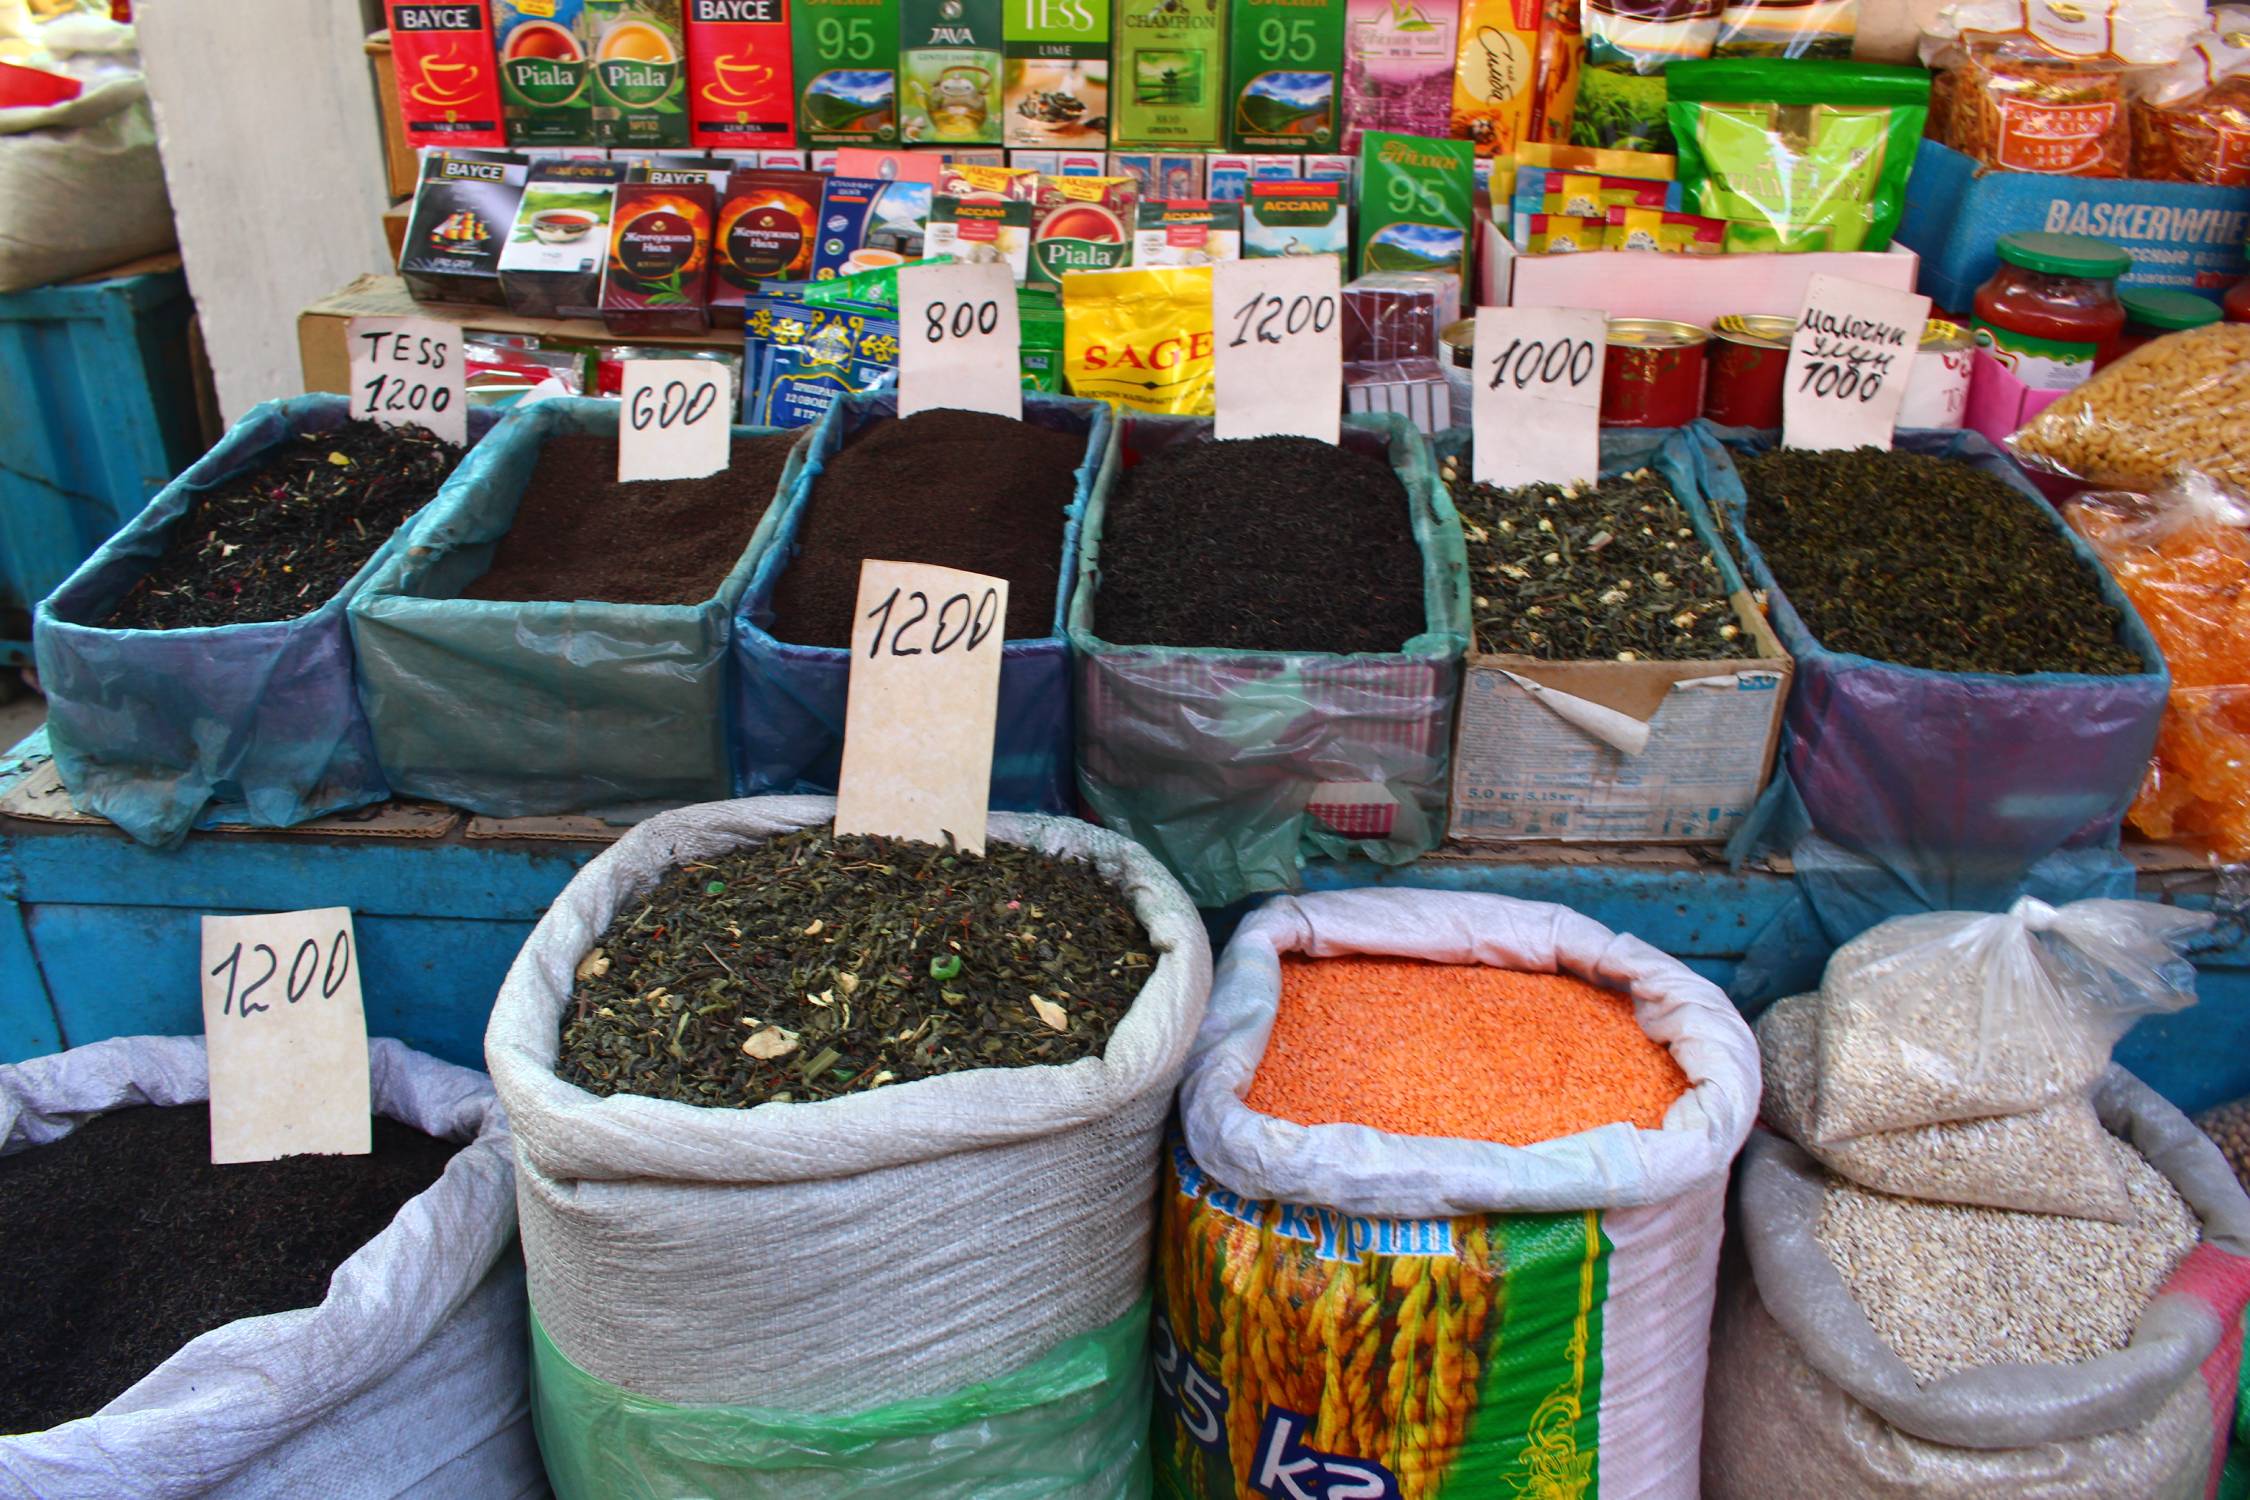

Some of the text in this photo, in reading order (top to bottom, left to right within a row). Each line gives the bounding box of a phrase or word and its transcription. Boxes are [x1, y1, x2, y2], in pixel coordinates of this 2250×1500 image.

[402, 9, 470, 28] BAYCE
[701, 0, 772, 19] BAYCE
[1125, 14, 1217, 29] CHAMPION
[816, 17, 875, 60] 95
[927, 27, 976, 45] JAVA
[1038, 45, 1073, 56] LIME
[1258, 18, 1317, 61] 95
[516, 65, 575, 86] Piala
[608, 66, 666, 87] Piala
[445, 162, 502, 179] BAYCE
[1387, 175, 1446, 217] 95
[1048, 244, 1111, 266] Piala
[925, 301, 997, 343] 800
[1229, 292, 1336, 348] 1200
[360, 332, 447, 369] TESS
[1083, 331, 1214, 370] SAGE
[1489, 337, 1594, 391] 1000
[364, 374, 451, 414] 1200
[1799, 361, 1882, 403] 1000
[631, 381, 718, 431] 600
[866, 587, 998, 660] 1200
[211, 930, 350, 1018] 1200
